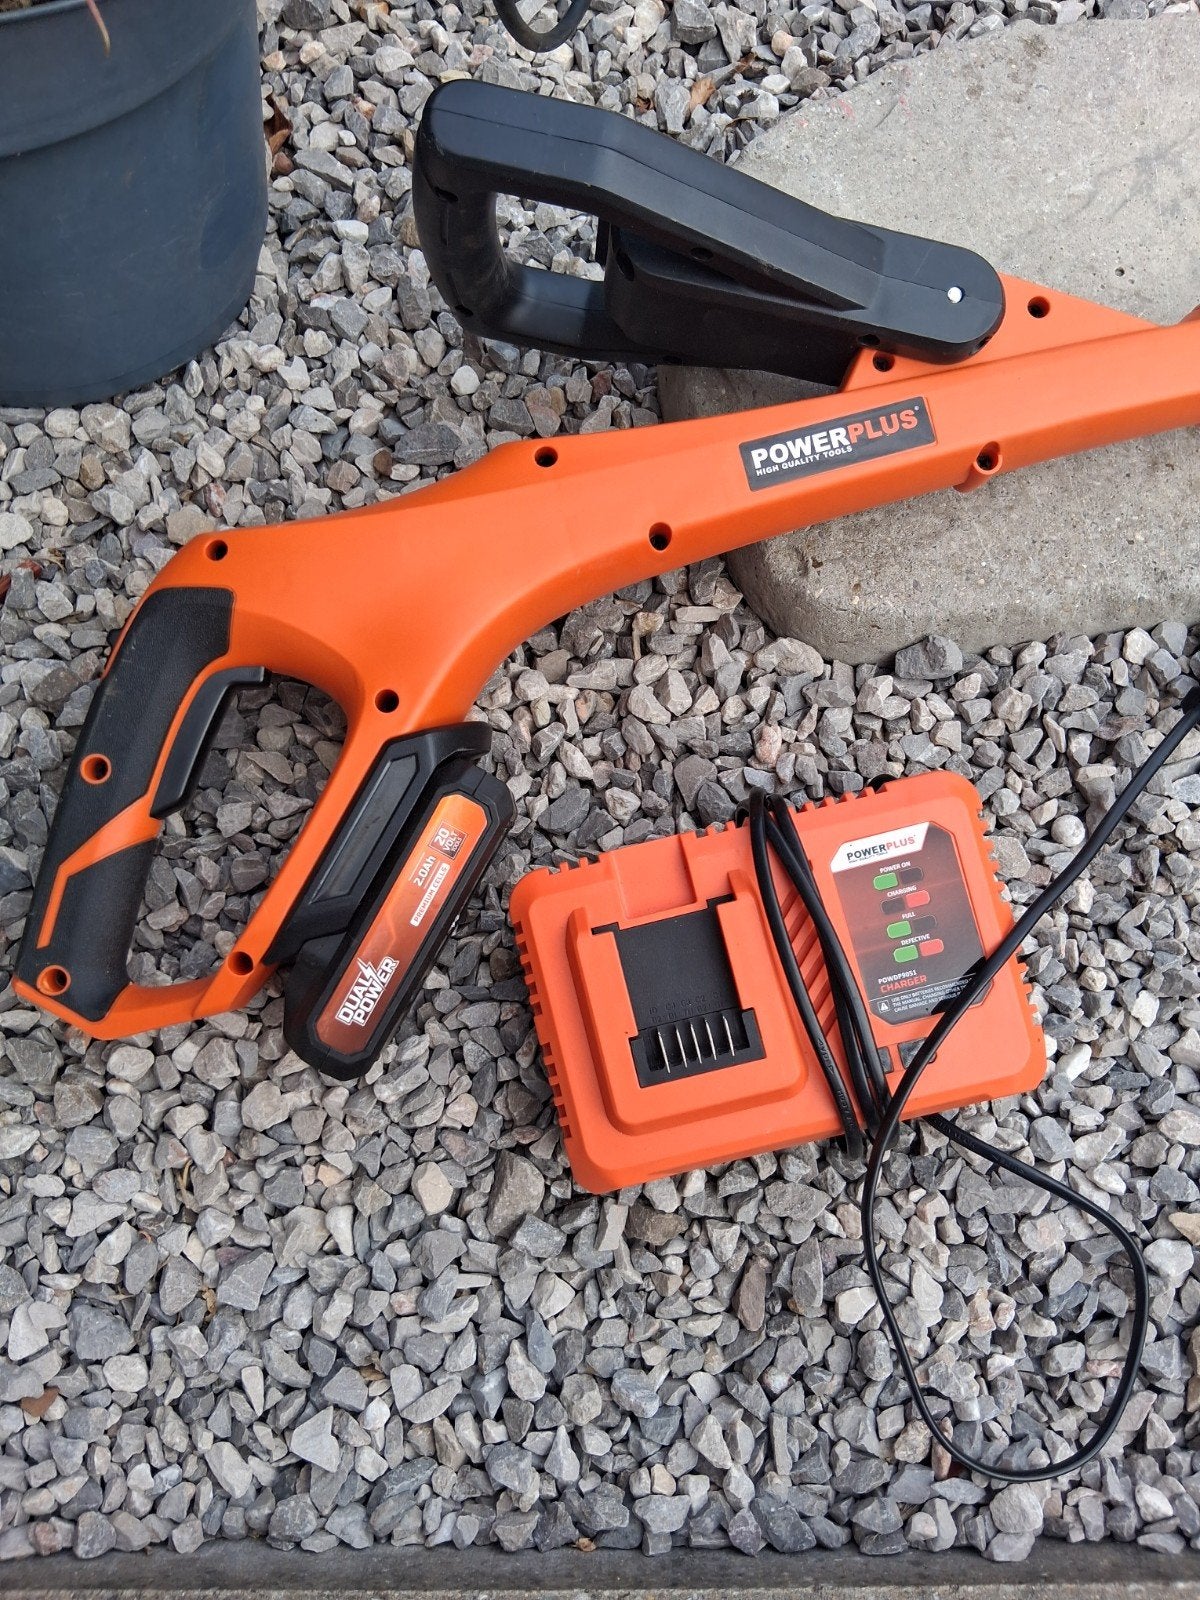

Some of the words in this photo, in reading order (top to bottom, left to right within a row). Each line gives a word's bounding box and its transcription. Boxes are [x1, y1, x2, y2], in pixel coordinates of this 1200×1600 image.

[751, 409, 918, 469] POWERPLUS
[755, 465, 780, 477] HIGH
[781, 454, 821, 470] QUALITY
[823, 445, 853, 458] TOOLS
[433, 827, 450, 845] 20
[443, 831, 460, 852] VOLT
[846, 837, 916, 861] POWERPLUS
[413, 855, 437, 887] 2.0Ah
[879, 863, 900, 874] POWER
[414, 888, 436, 923] PREMIUM
[432, 865, 449, 891] CELLS
[886, 885, 917, 898] CHARGING
[901, 912, 916, 920] FULL
[900, 934, 931, 946] DEFECTIVE
[352, 956, 399, 1026] POWER
[880, 975, 928, 993] CHARGER
[336, 974, 375, 1026] DUAL
